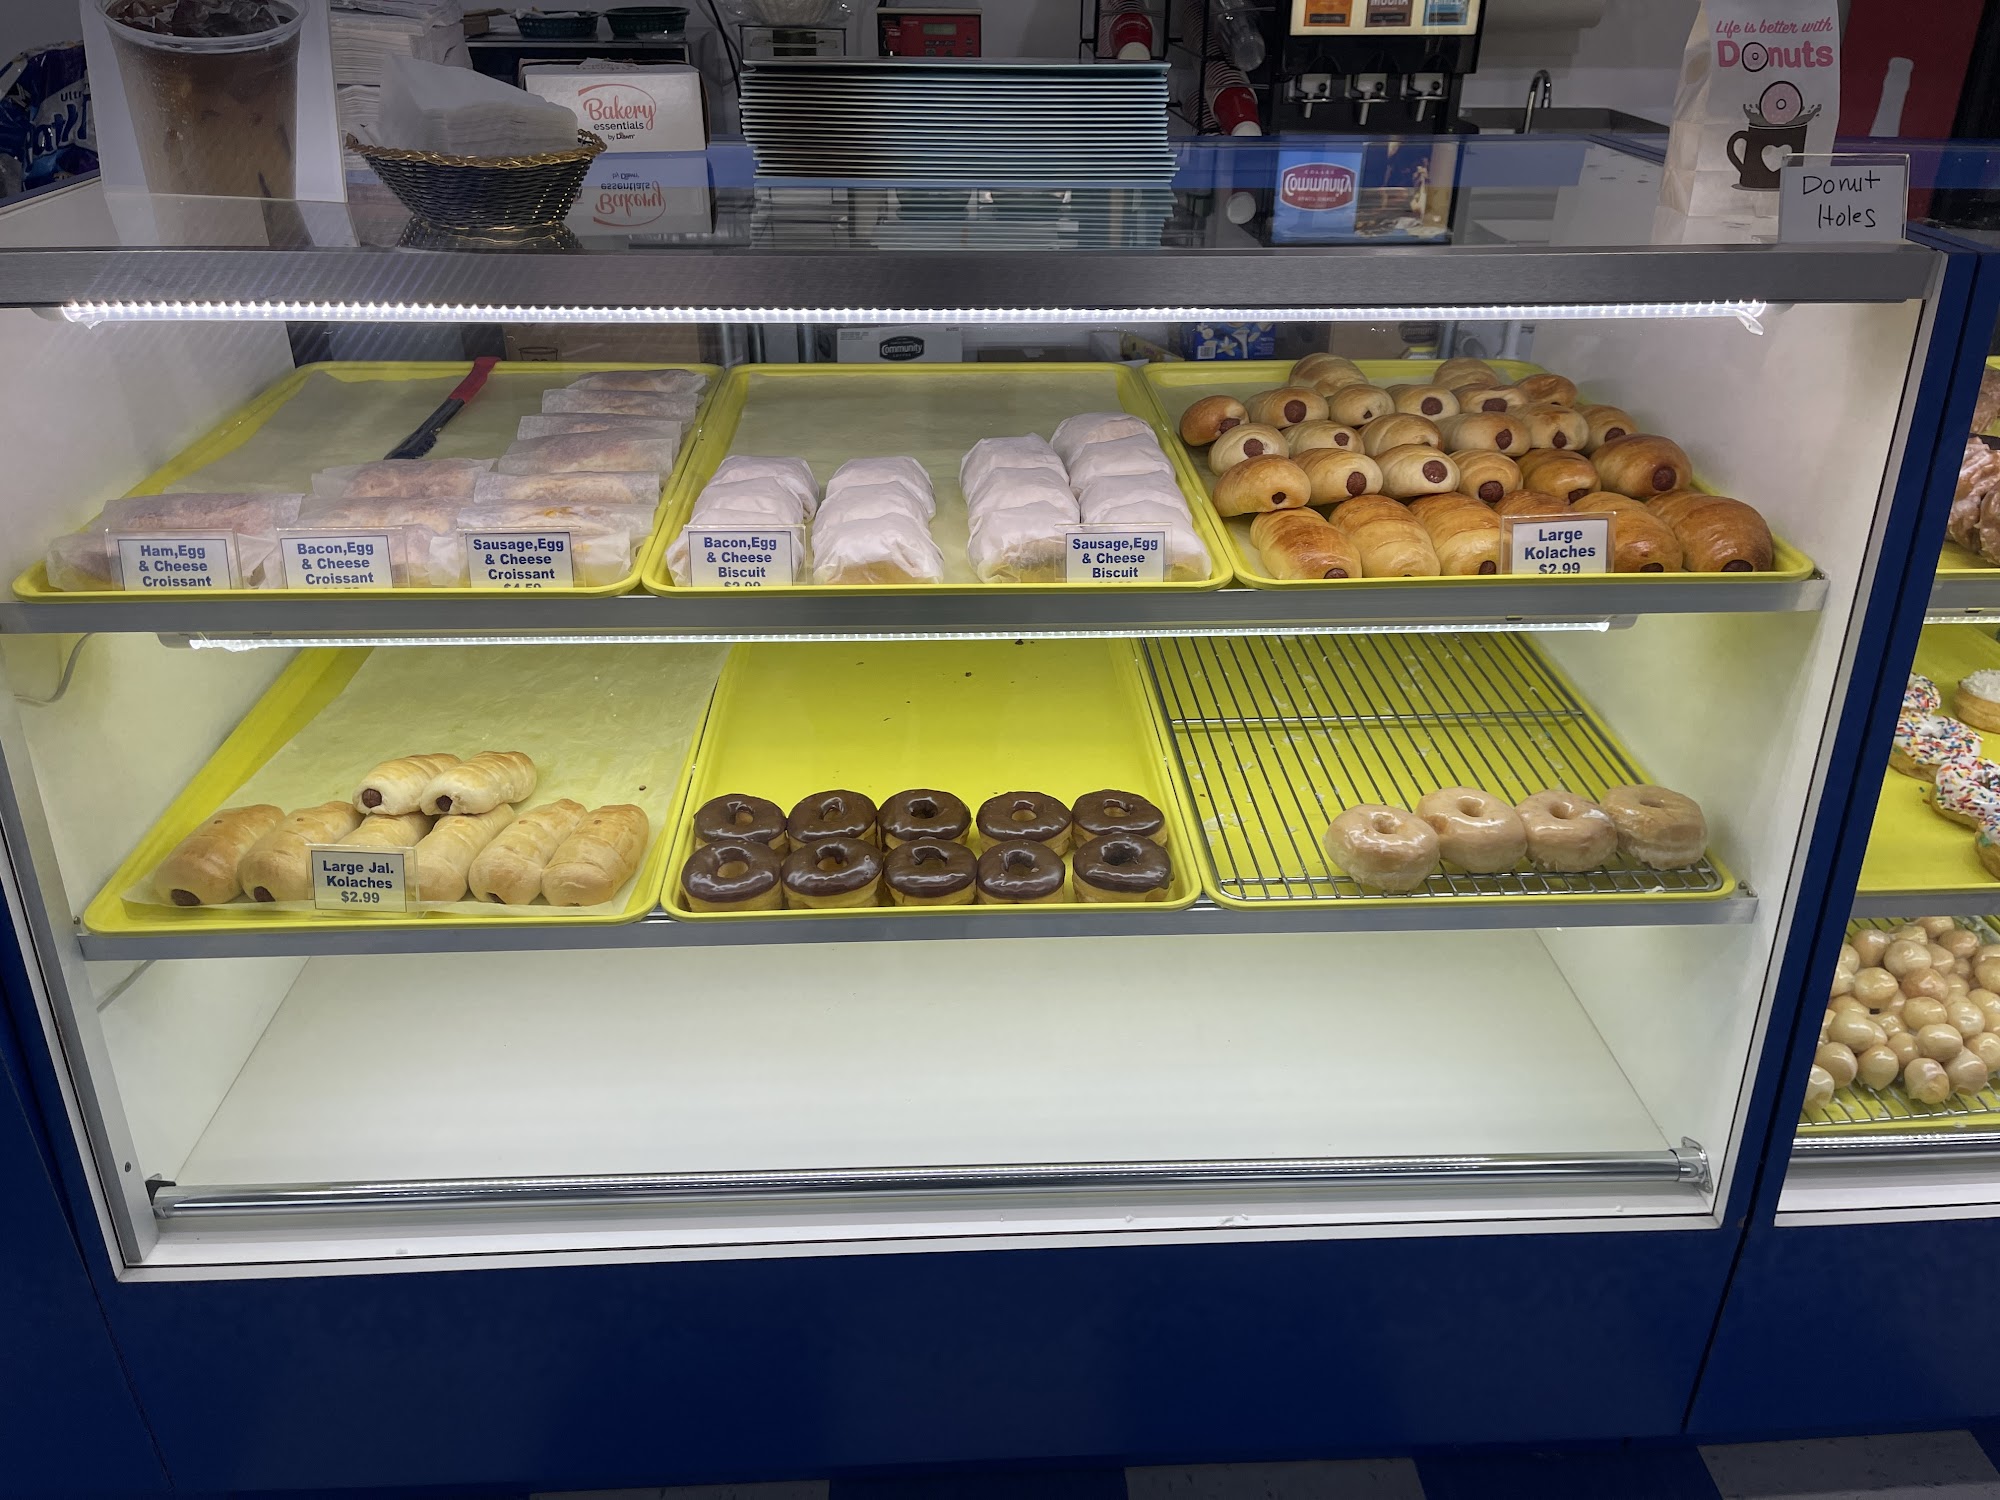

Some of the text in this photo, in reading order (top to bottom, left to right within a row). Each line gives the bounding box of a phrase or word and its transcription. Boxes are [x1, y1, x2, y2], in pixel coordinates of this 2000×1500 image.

[1716, 17, 1832, 38] Life is better with
[1717, 40, 1834, 72] Donuts
[583, 95, 655, 130] Bakery
[593, 121, 644, 130] essentials
[1802, 170, 1881, 196] Donut
[1818, 204, 1876, 228] Holes
[881, 344, 922, 356] Community
[1538, 529, 1583, 544] Large
[297, 542, 374, 556] Bacon,Egg
[473, 538, 564, 552] Sausage,Egg
[703, 536, 777, 551] Bacon,Egg
[1072, 537, 1158, 552] Sausage,Egg
[140, 545, 206, 559] Ham,Egg
[706, 552, 772, 563] & Cheese
[1082, 553, 1145, 564] & Cheese
[1524, 545, 1596, 560] Kolaches
[139, 560, 208, 572] & Cheese
[301, 558, 370, 570] & Cheese
[485, 554, 552, 565] & Cheese
[488, 568, 555, 580] Croissant
[718, 566, 766, 578] Biscuit
[1092, 567, 1138, 578] Biscuit
[1538, 562, 1581, 574] $2.99
[142, 575, 212, 587] Croissant
[305, 572, 374, 585] Croissant
[323, 860, 394, 875] Large Jal.
[326, 875, 393, 889] Kolaches
[341, 891, 380, 903] $2.99
